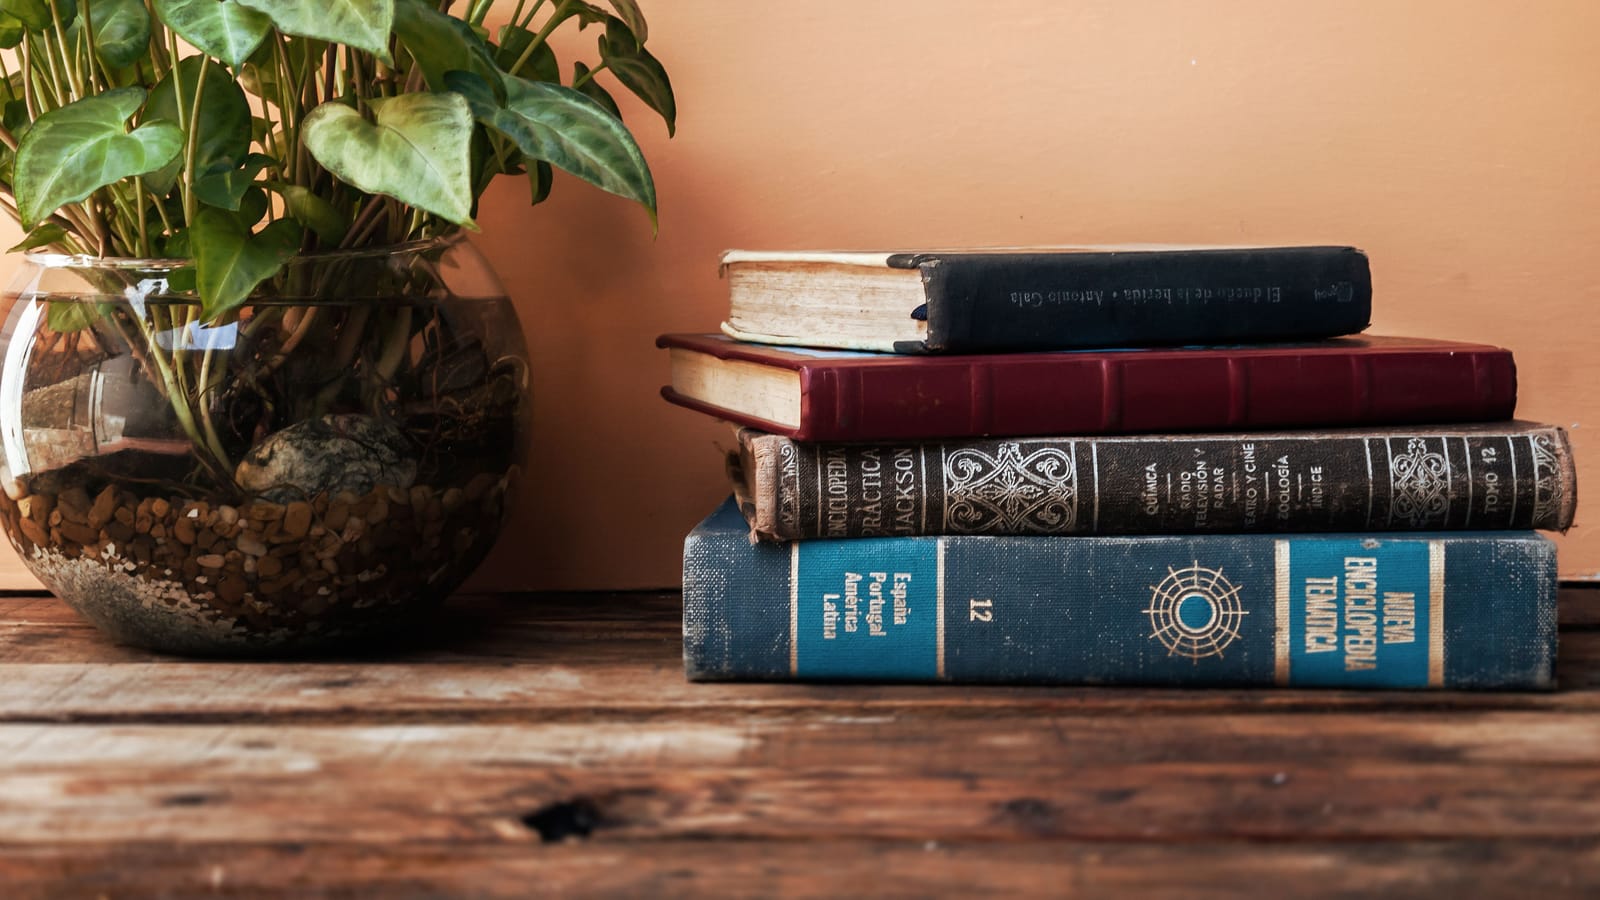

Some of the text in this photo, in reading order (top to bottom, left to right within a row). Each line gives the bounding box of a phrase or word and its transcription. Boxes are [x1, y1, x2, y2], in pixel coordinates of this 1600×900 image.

[1010, 291, 1043, 308] Gala
[1047, 290, 1104, 307] Antonio
[1123, 288, 1172, 305] herida
[1243, 443, 1256, 473] CINE
[1246, 474, 1257, 484] Y
[1481, 447, 1500, 515] TOMO 12
[893, 448, 915, 535] JACKSON
[1142, 463, 1160, 515] QUÍMICA
[1180, 470, 1193, 510] RADIO
[1193, 460, 1209, 528] TELEVISIÓN
[1213, 467, 1225, 509] RADAR
[1271, 455, 1290, 520] ZOOLOGÍA
[823, 593, 841, 640] Latina
[844, 572, 863, 633] América
[865, 571, 887, 637] Portugal
[890, 572, 912, 625] España
[969, 598, 993, 622] 12
[1304, 576, 1338, 654] TEMATICA
[1344, 556, 1377, 672] ENCICLOPEDIA
[1383, 591, 1416, 645] NUEVA
